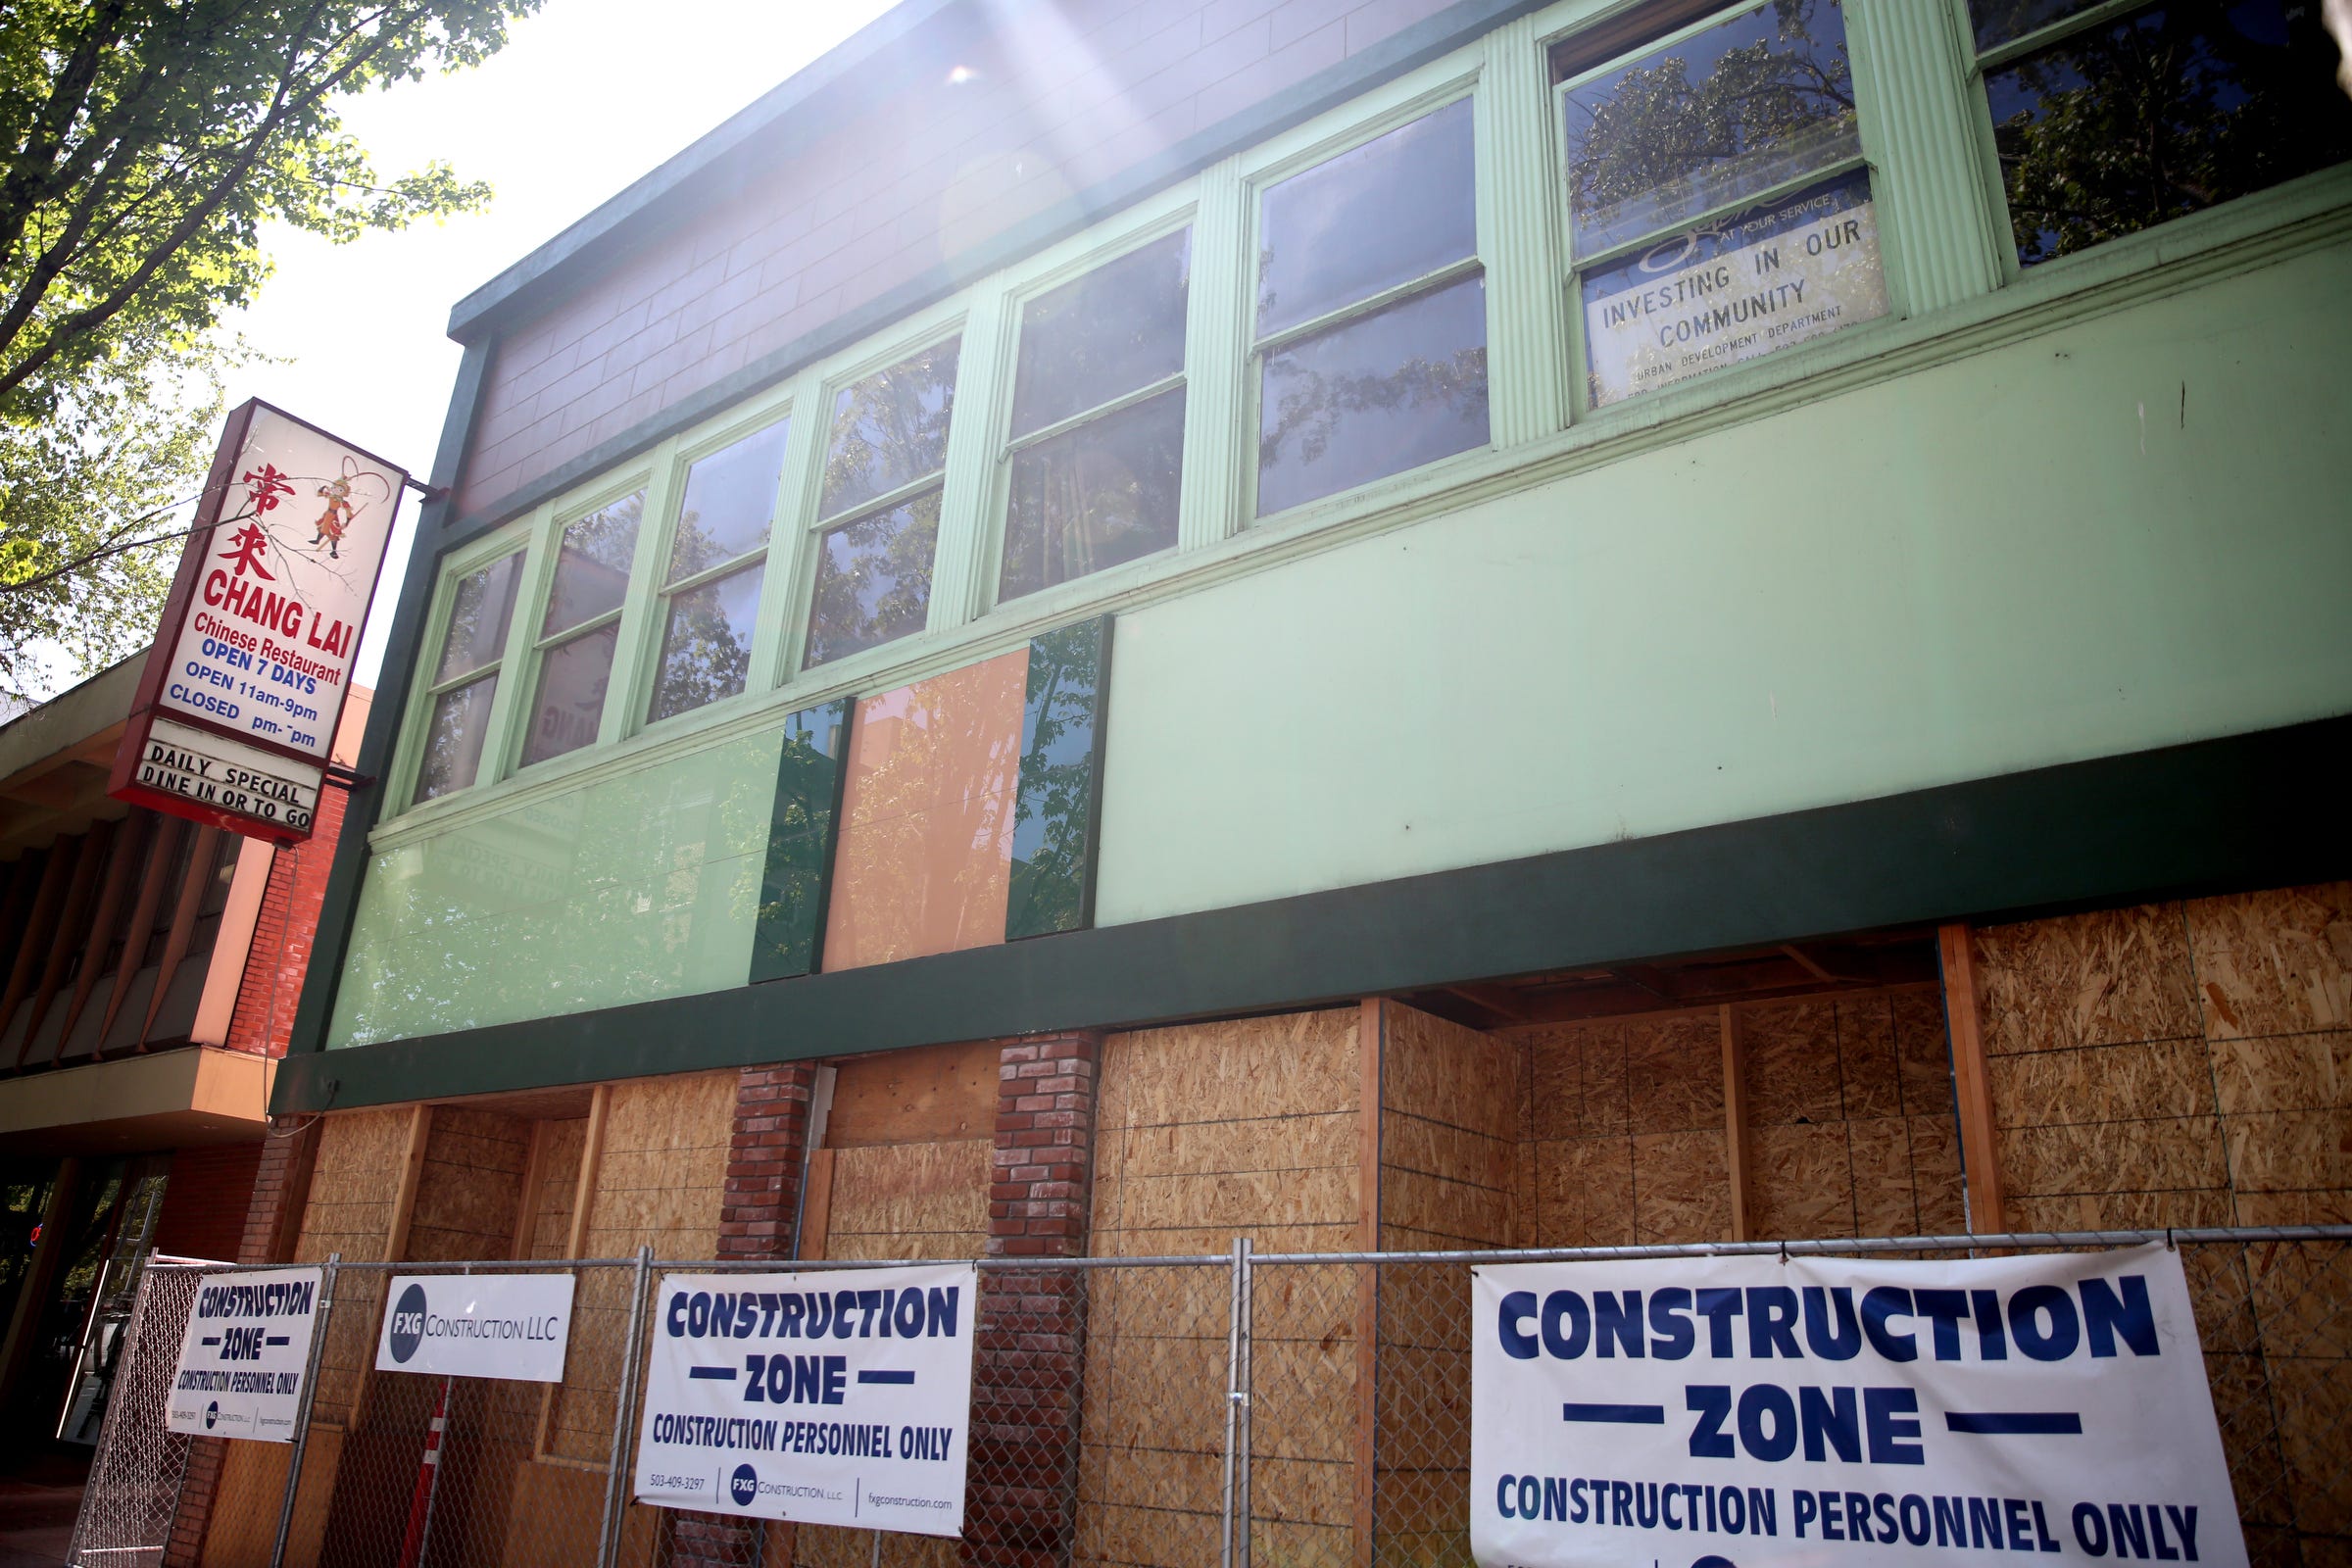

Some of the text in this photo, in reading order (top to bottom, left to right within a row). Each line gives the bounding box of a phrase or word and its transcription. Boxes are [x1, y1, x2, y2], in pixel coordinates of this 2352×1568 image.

[1740, 215, 1777, 237] YOUR
[1779, 194, 1830, 221] SERVICE
[1603, 220, 1860, 328] INVESTING IN OUR
[1659, 278, 1805, 348] COMMUNITY
[1637, 362, 1672, 381] URBAN
[1681, 333, 1757, 367] DEVELOPMENT
[1768, 305, 1841, 338] DEPARTMENT
[203, 568, 354, 660] CHANG LAI
[194, 612, 342, 686] Chinese Restaurant
[201, 637, 318, 695] OPEN 7 DAYS
[170, 683, 241, 720] CLOSED
[185, 661, 318, 722] OPEN 11am-9pm
[143, 765, 310, 828] DINE IN OR TO GO
[150, 745, 300, 805] DAILY SPECIAL
[199, 1281, 315, 1318] CONSTRUCTION
[394, 1312, 558, 1341] FXG CONSTRUCTION LLC
[666, 1286, 959, 1339] CONSTRUCTION
[1497, 1275, 2160, 1363] CONSTRUCTION
[220, 1327, 266, 1360] ZONE
[177, 1370, 299, 1395] CONSTRUCTION PERSONNEL ONLY
[744, 1353, 847, 1404] ZONE
[653, 1413, 953, 1461] CONSTRUCTION PERSONNEL ONLY
[1685, 1383, 1926, 1466] ZONE
[650, 1474, 705, 1491] 503-409-3297
[733, 1478, 755, 1493] FXG
[868, 1492, 953, 1510] fxgconstruction.com
[1496, 1474, 2199, 1562] CONSTRUCTION PERSONNEL ONLY
